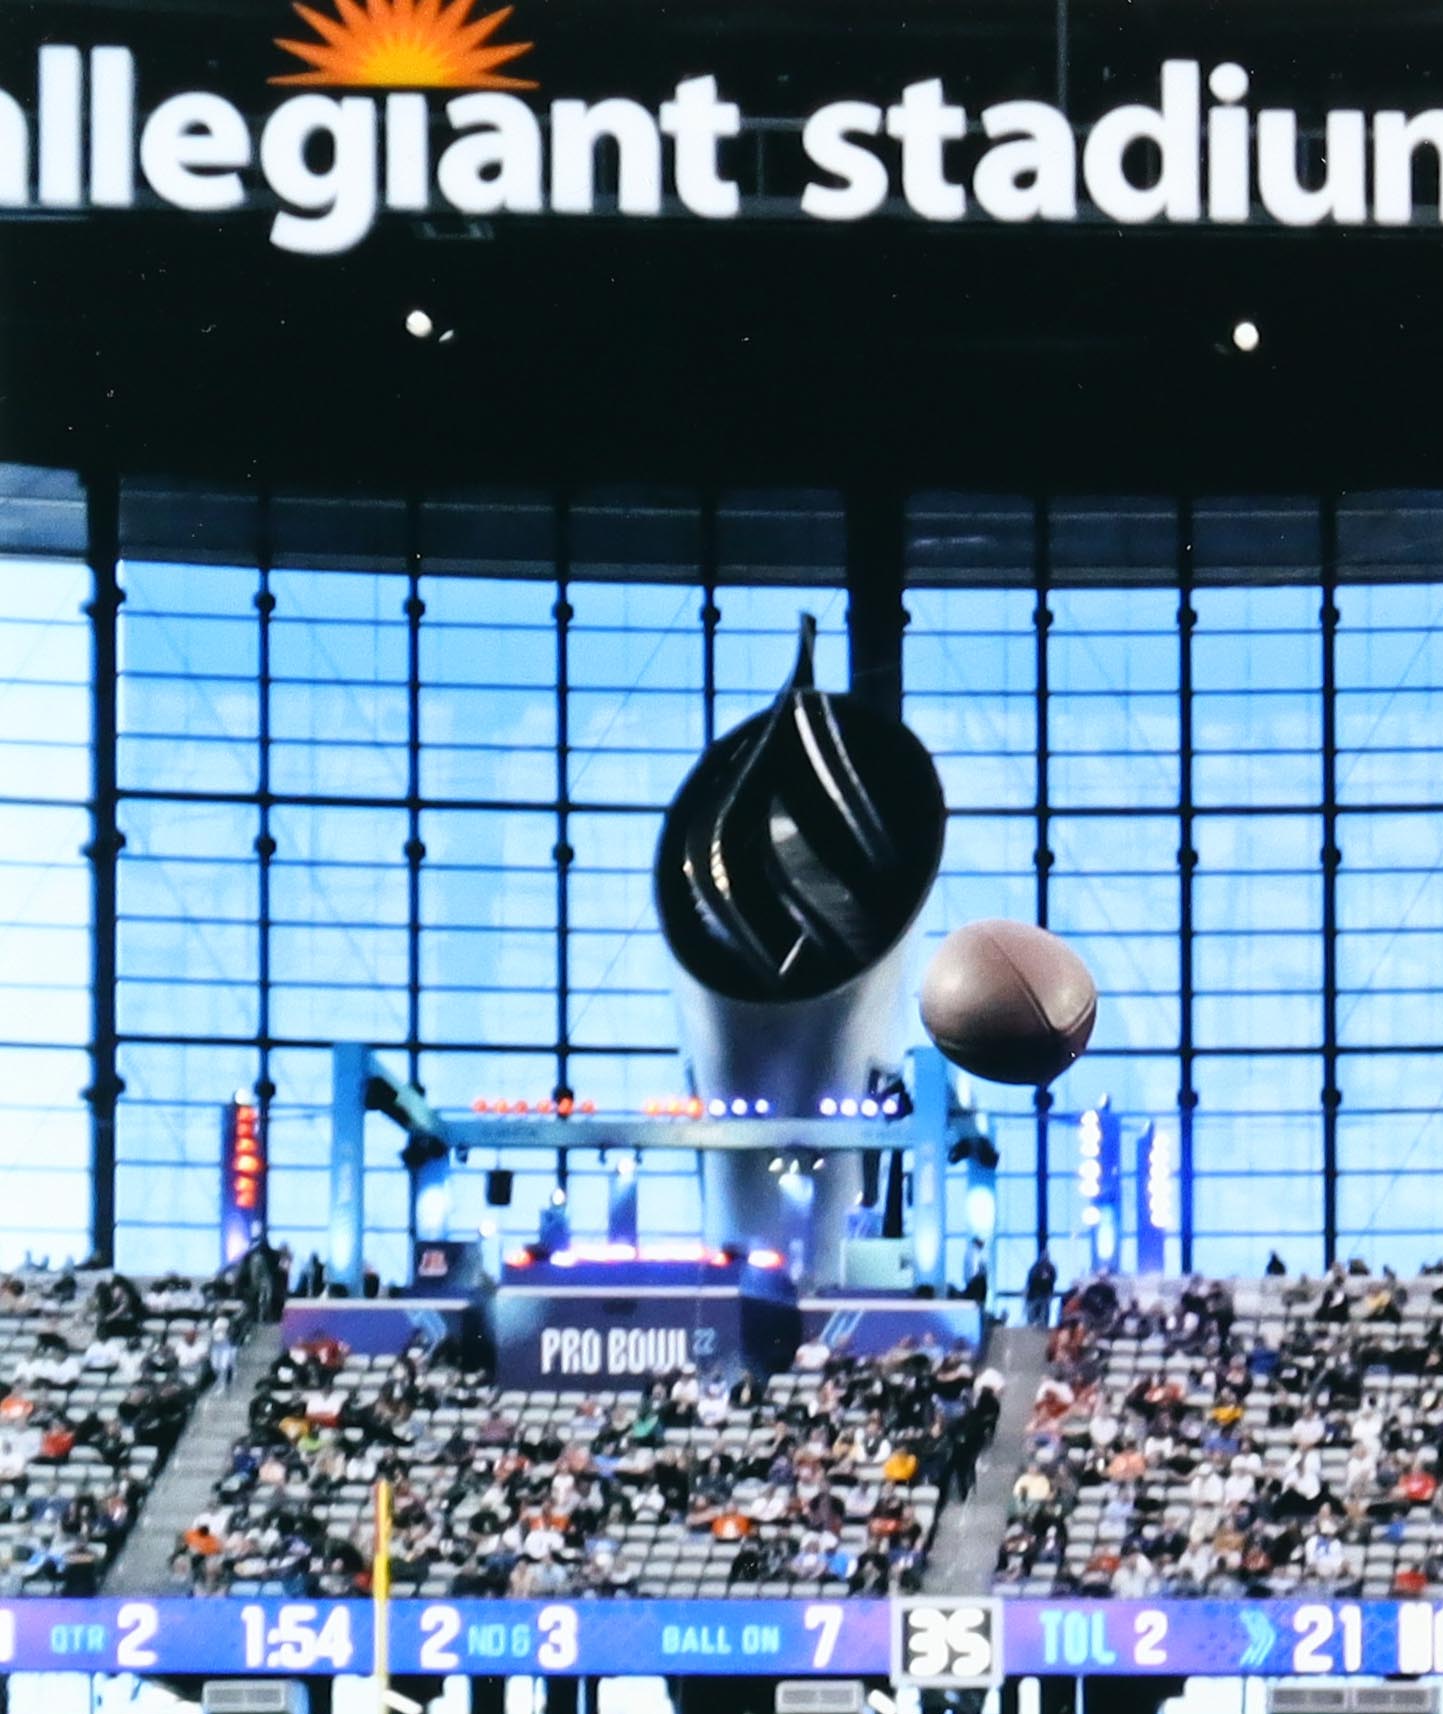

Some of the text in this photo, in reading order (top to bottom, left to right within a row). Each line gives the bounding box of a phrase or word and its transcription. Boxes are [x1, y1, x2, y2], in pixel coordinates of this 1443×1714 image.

[0, 45, 741, 256] llegiant
[540, 1327, 601, 1374] PRO
[607, 1327, 697, 1374] BOWL
[116, 1603, 160, 1668] 2
[240, 1603, 353, 1669] 1:54
[536, 1604, 578, 1670] 3
[662, 1625, 732, 1655] BALL
[742, 1625, 780, 1655] ON
[803, 1604, 845, 1668] 7
[907, 1606, 992, 1678] 35
[1039, 1609, 1116, 1665] TOL
[1134, 1609, 1169, 1666] 2
[1293, 1604, 1362, 1673] 21
